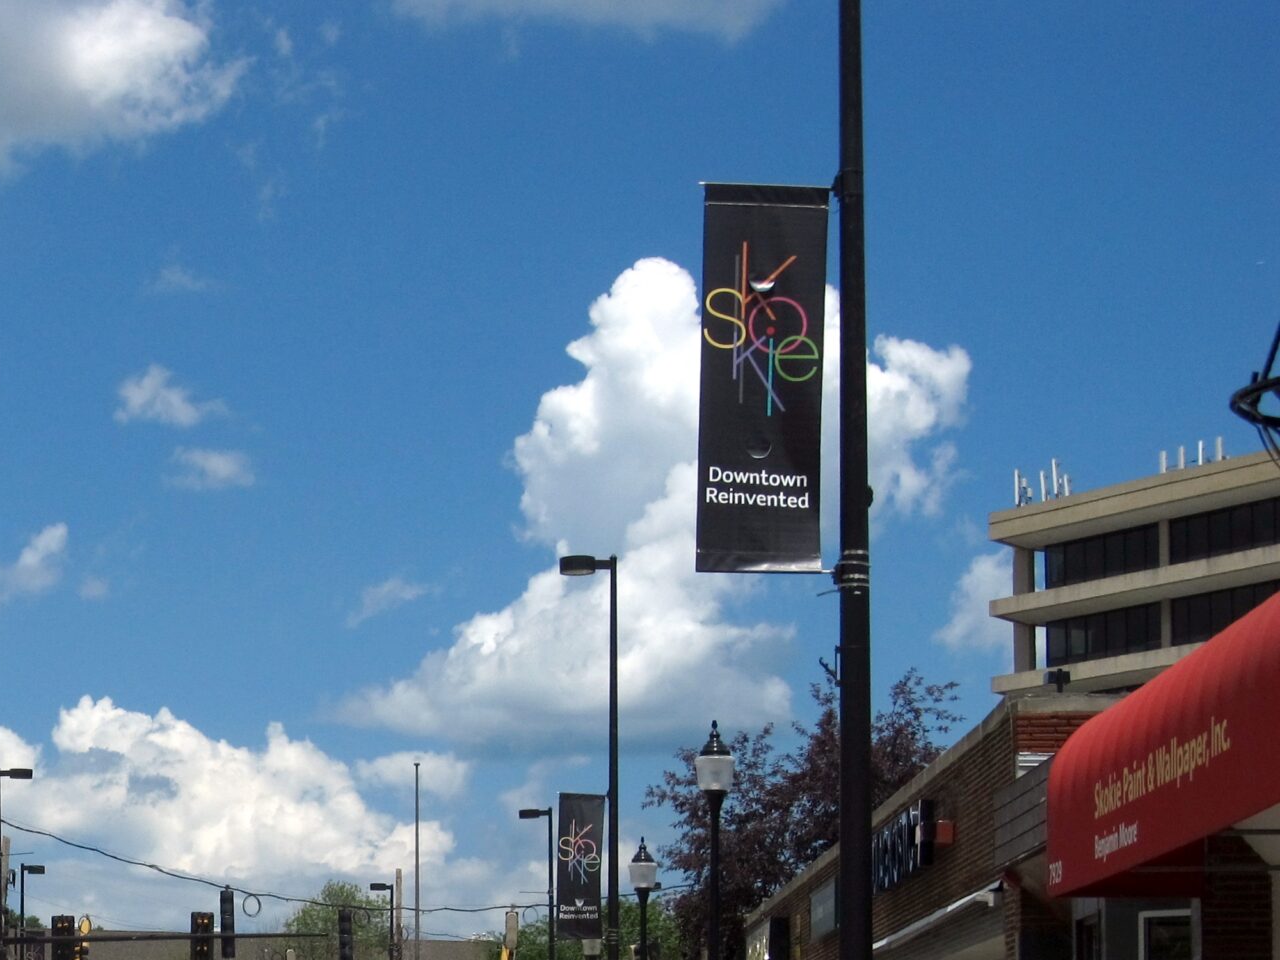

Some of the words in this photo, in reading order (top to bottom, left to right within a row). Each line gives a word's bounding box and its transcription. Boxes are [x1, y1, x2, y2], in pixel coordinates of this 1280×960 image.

[708, 466, 808, 487] Downtown
[705, 487, 809, 508] Reinvented
[1094, 773, 1121, 819] Skokie
[1122, 760, 1146, 805] Paint
[1147, 753, 1155, 792] &
[1155, 731, 1210, 788] Wallpaper,
[1211, 716, 1231, 758] Inc.
[1094, 826, 1120, 863] Benjamin
[1119, 821, 1138, 849] Moore
